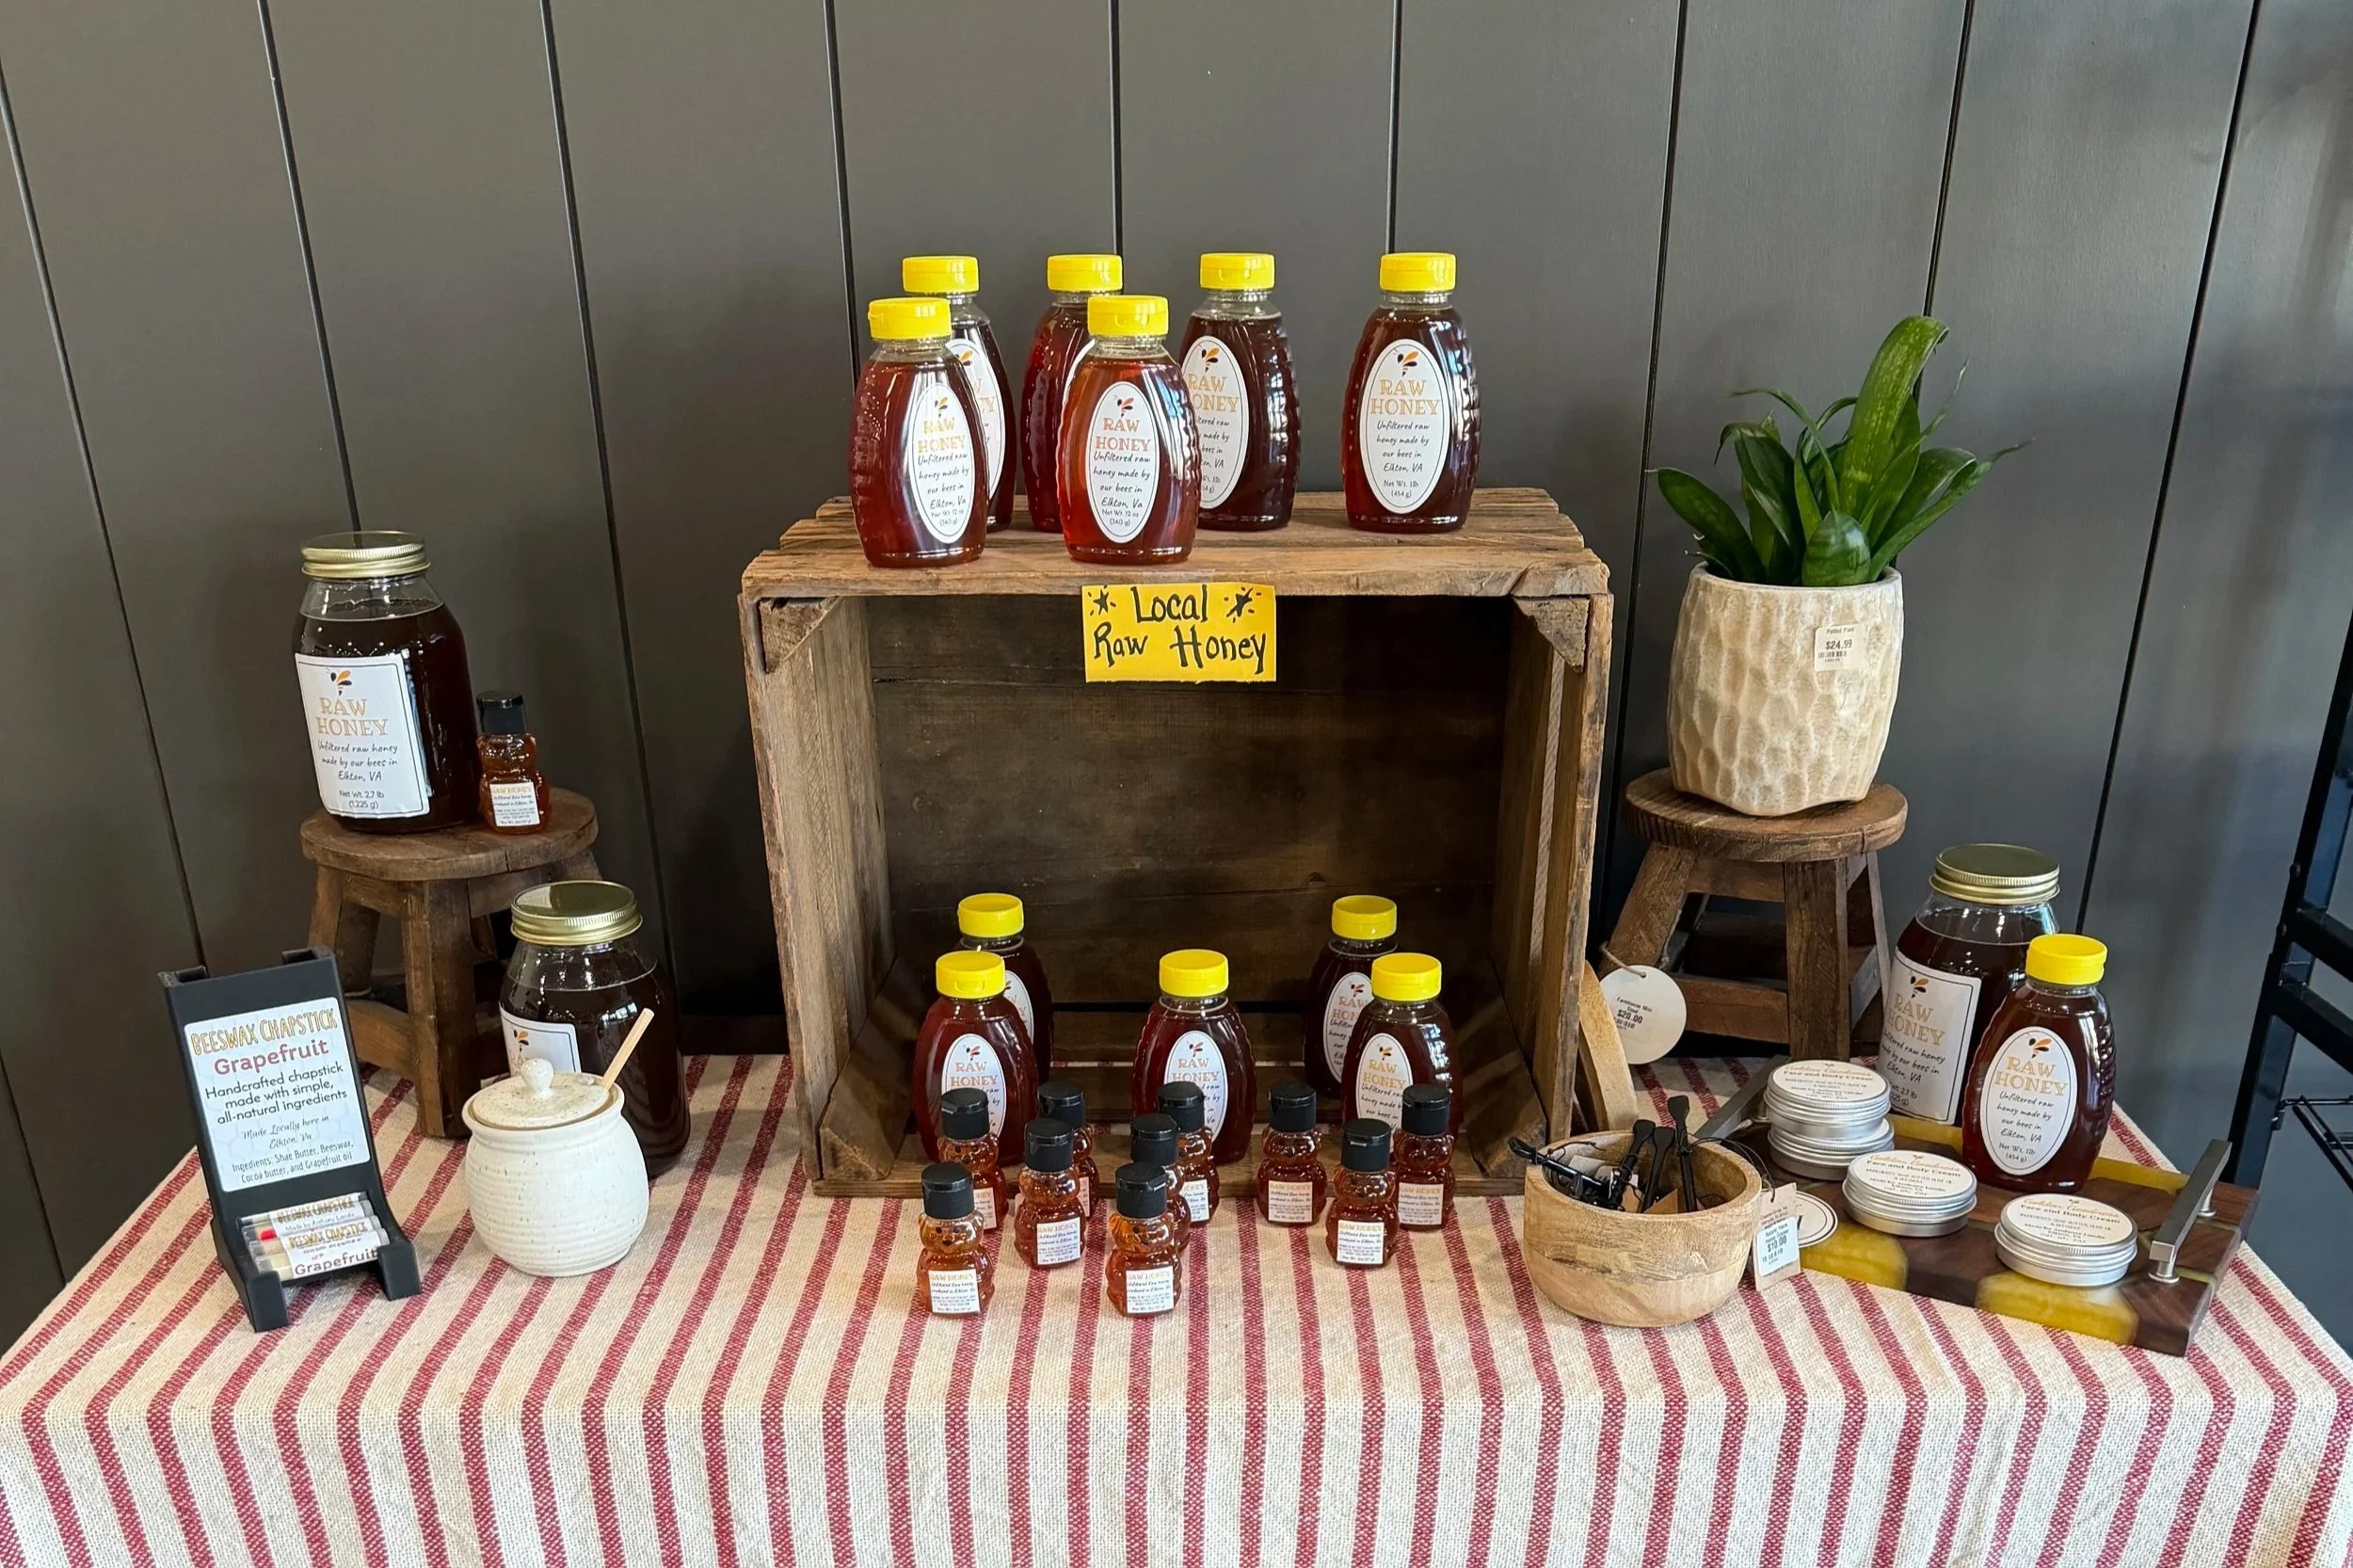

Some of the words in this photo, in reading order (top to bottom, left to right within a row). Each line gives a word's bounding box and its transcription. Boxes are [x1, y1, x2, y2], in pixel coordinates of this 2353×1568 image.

[1188, 374, 1227, 392] RAW
[1379, 379, 1427, 396] RAW
[1192, 394, 1240, 413] ONEY
[1369, 398, 1441, 415] HONEY
[923, 417, 954, 434] RAW
[1103, 417, 1140, 433] RAW
[1377, 420, 1414, 430] Unfiltered
[918, 435, 966, 454] HONEY
[1096, 436, 1151, 452] HONEY
[1376, 435, 1398, 447] honey
[1400, 436, 1418, 444] made
[1420, 436, 1430, 447] by
[918, 452, 952, 466] Unfiltered
[1094, 452, 1132, 462] Unfiltered
[1397, 450, 1412, 458] bees
[1415, 450, 1422, 458] in
[1094, 467, 1115, 480] honey
[1118, 469, 1138, 478] made
[1141, 469, 1150, 480] by
[1412, 463, 1423, 472] VA
[919, 471, 940, 481] honey
[1115, 483, 1132, 492] bees
[1134, 485, 1143, 493] in
[1132, 498, 1143, 508] Va
[1130, 584, 1209, 623] Local
[1094, 621, 1148, 668] Raw
[1169, 625, 1266, 675] Honey
[1825, 639, 1852, 650] $24.99
[319, 697, 367, 716] RAW
[315, 717, 389, 736] HONEY
[317, 740, 350, 753] Unfiltered
[372, 744, 398, 755] honey
[339, 758, 348, 769] by
[367, 758, 386, 767] bees
[338, 770, 366, 783] Elkton,
[369, 771, 382, 781] VA
[339, 790, 351, 798] Net
[1895, 993, 1932, 1023] RAW
[1617, 1009, 1643, 1024] $20.00
[190, 1023, 259, 1056] BEESWAX
[259, 1007, 339, 1042] CHAPSTICK
[1886, 1009, 1945, 1046] HONEY
[214, 1038, 329, 1076] Grapefruit
[1904, 1044, 1920, 1055] raw
[1920, 1048, 1945, 1064] honey
[955, 1061, 987, 1073] RAW
[1177, 1058, 1209, 1069] RAW
[1369, 1059, 1398, 1075] RAW
[1912, 1060, 1929, 1073] bees
[1930, 1066, 1940, 1075] in
[2007, 1056, 2057, 1079] RAW
[204, 1072, 284, 1100] Handcrafted
[288, 1061, 344, 1085] chapstick
[951, 1074, 999, 1087] HONEY
[1171, 1071, 1220, 1082] HONEY
[1363, 1073, 1406, 1090] HONEY
[1910, 1070, 1922, 1084] VA
[1994, 1071, 2069, 1096] HONEY
[224, 1092, 262, 1110] made
[264, 1085, 290, 1102] with
[292, 1079, 335, 1097] simple,
[1361, 1083, 1391, 1096] Unfiltered
[1361, 1095, 1378, 1107] honey
[1999, 1091, 2037, 1106] Unfiltered
[216, 1101, 280, 1126] all-natural
[283, 1088, 347, 1112] ingredients
[1996, 1103, 2019, 1116] honey
[2020, 1108, 2041, 1118] made
[2042, 1111, 2052, 1122] by
[241, 1128, 267, 1141] Made
[302, 1117, 319, 1128] here
[2016, 1119, 2033, 1129] bees
[2030, 1132, 2042, 1143] VA
[274, 1151, 294, 1163] Shae
[320, 1140, 354, 1153] Beeswax,
[241, 1172, 264, 1184] Cocoa
[290, 1161, 304, 1173] and
[305, 1154, 342, 1170] Grapefruit
[343, 1150, 353, 1160] oil
[289, 1230, 326, 1249] BEESWAX
[295, 1248, 378, 1275] Grapefruit
